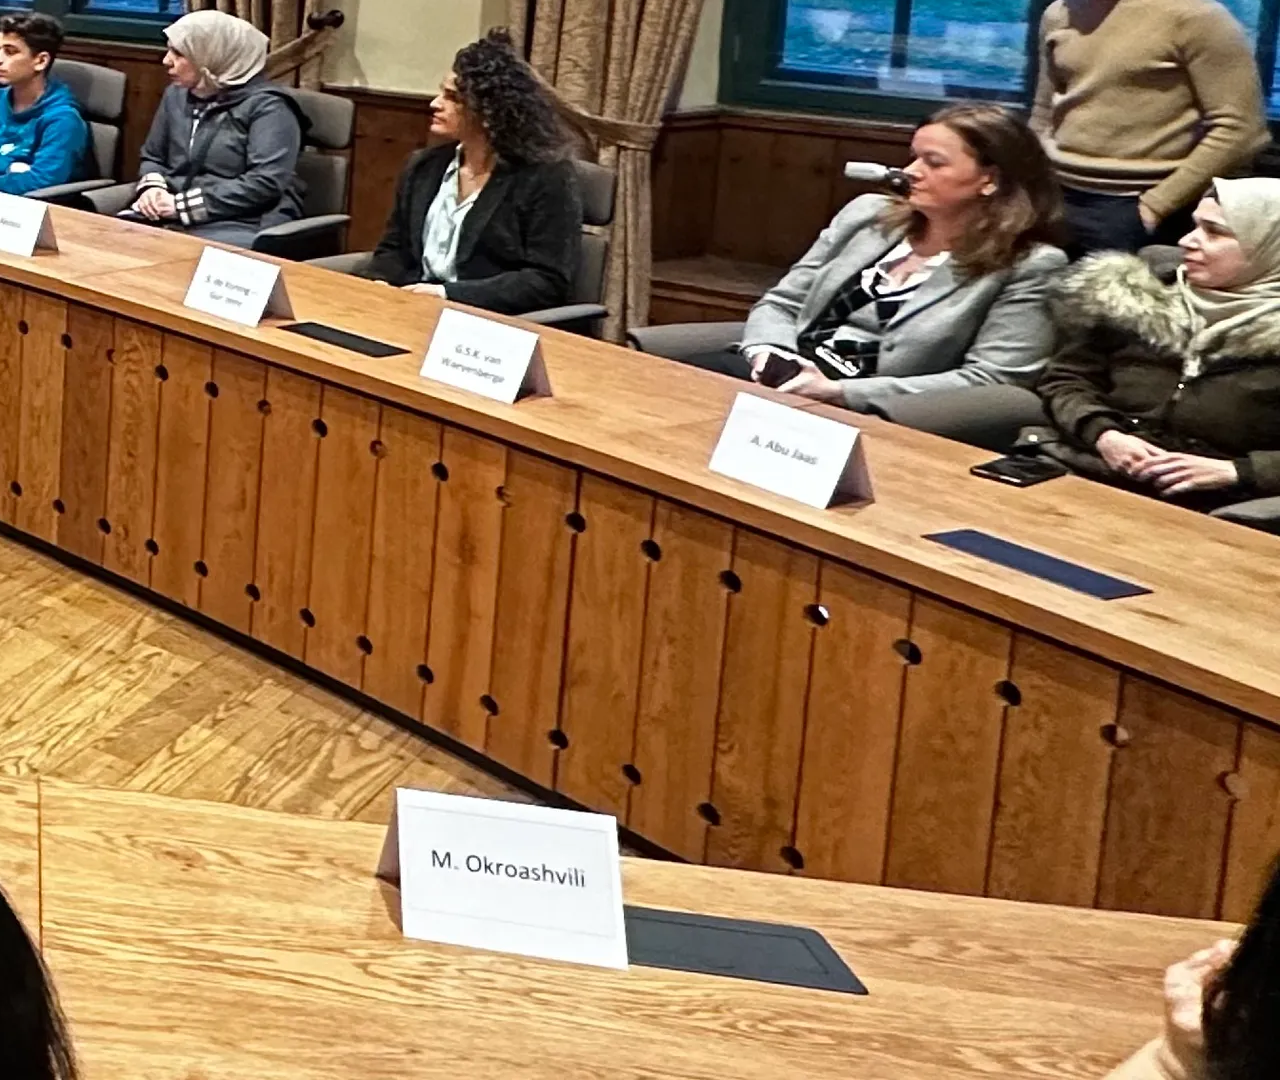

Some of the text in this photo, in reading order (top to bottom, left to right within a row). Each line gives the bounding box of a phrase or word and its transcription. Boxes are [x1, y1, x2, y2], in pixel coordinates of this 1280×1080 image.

[483, 354, 501, 365] van
[750, 435, 762, 448] A.
[765, 440, 789, 456] Abu
[431, 849, 586, 888] M. Okroashvili
